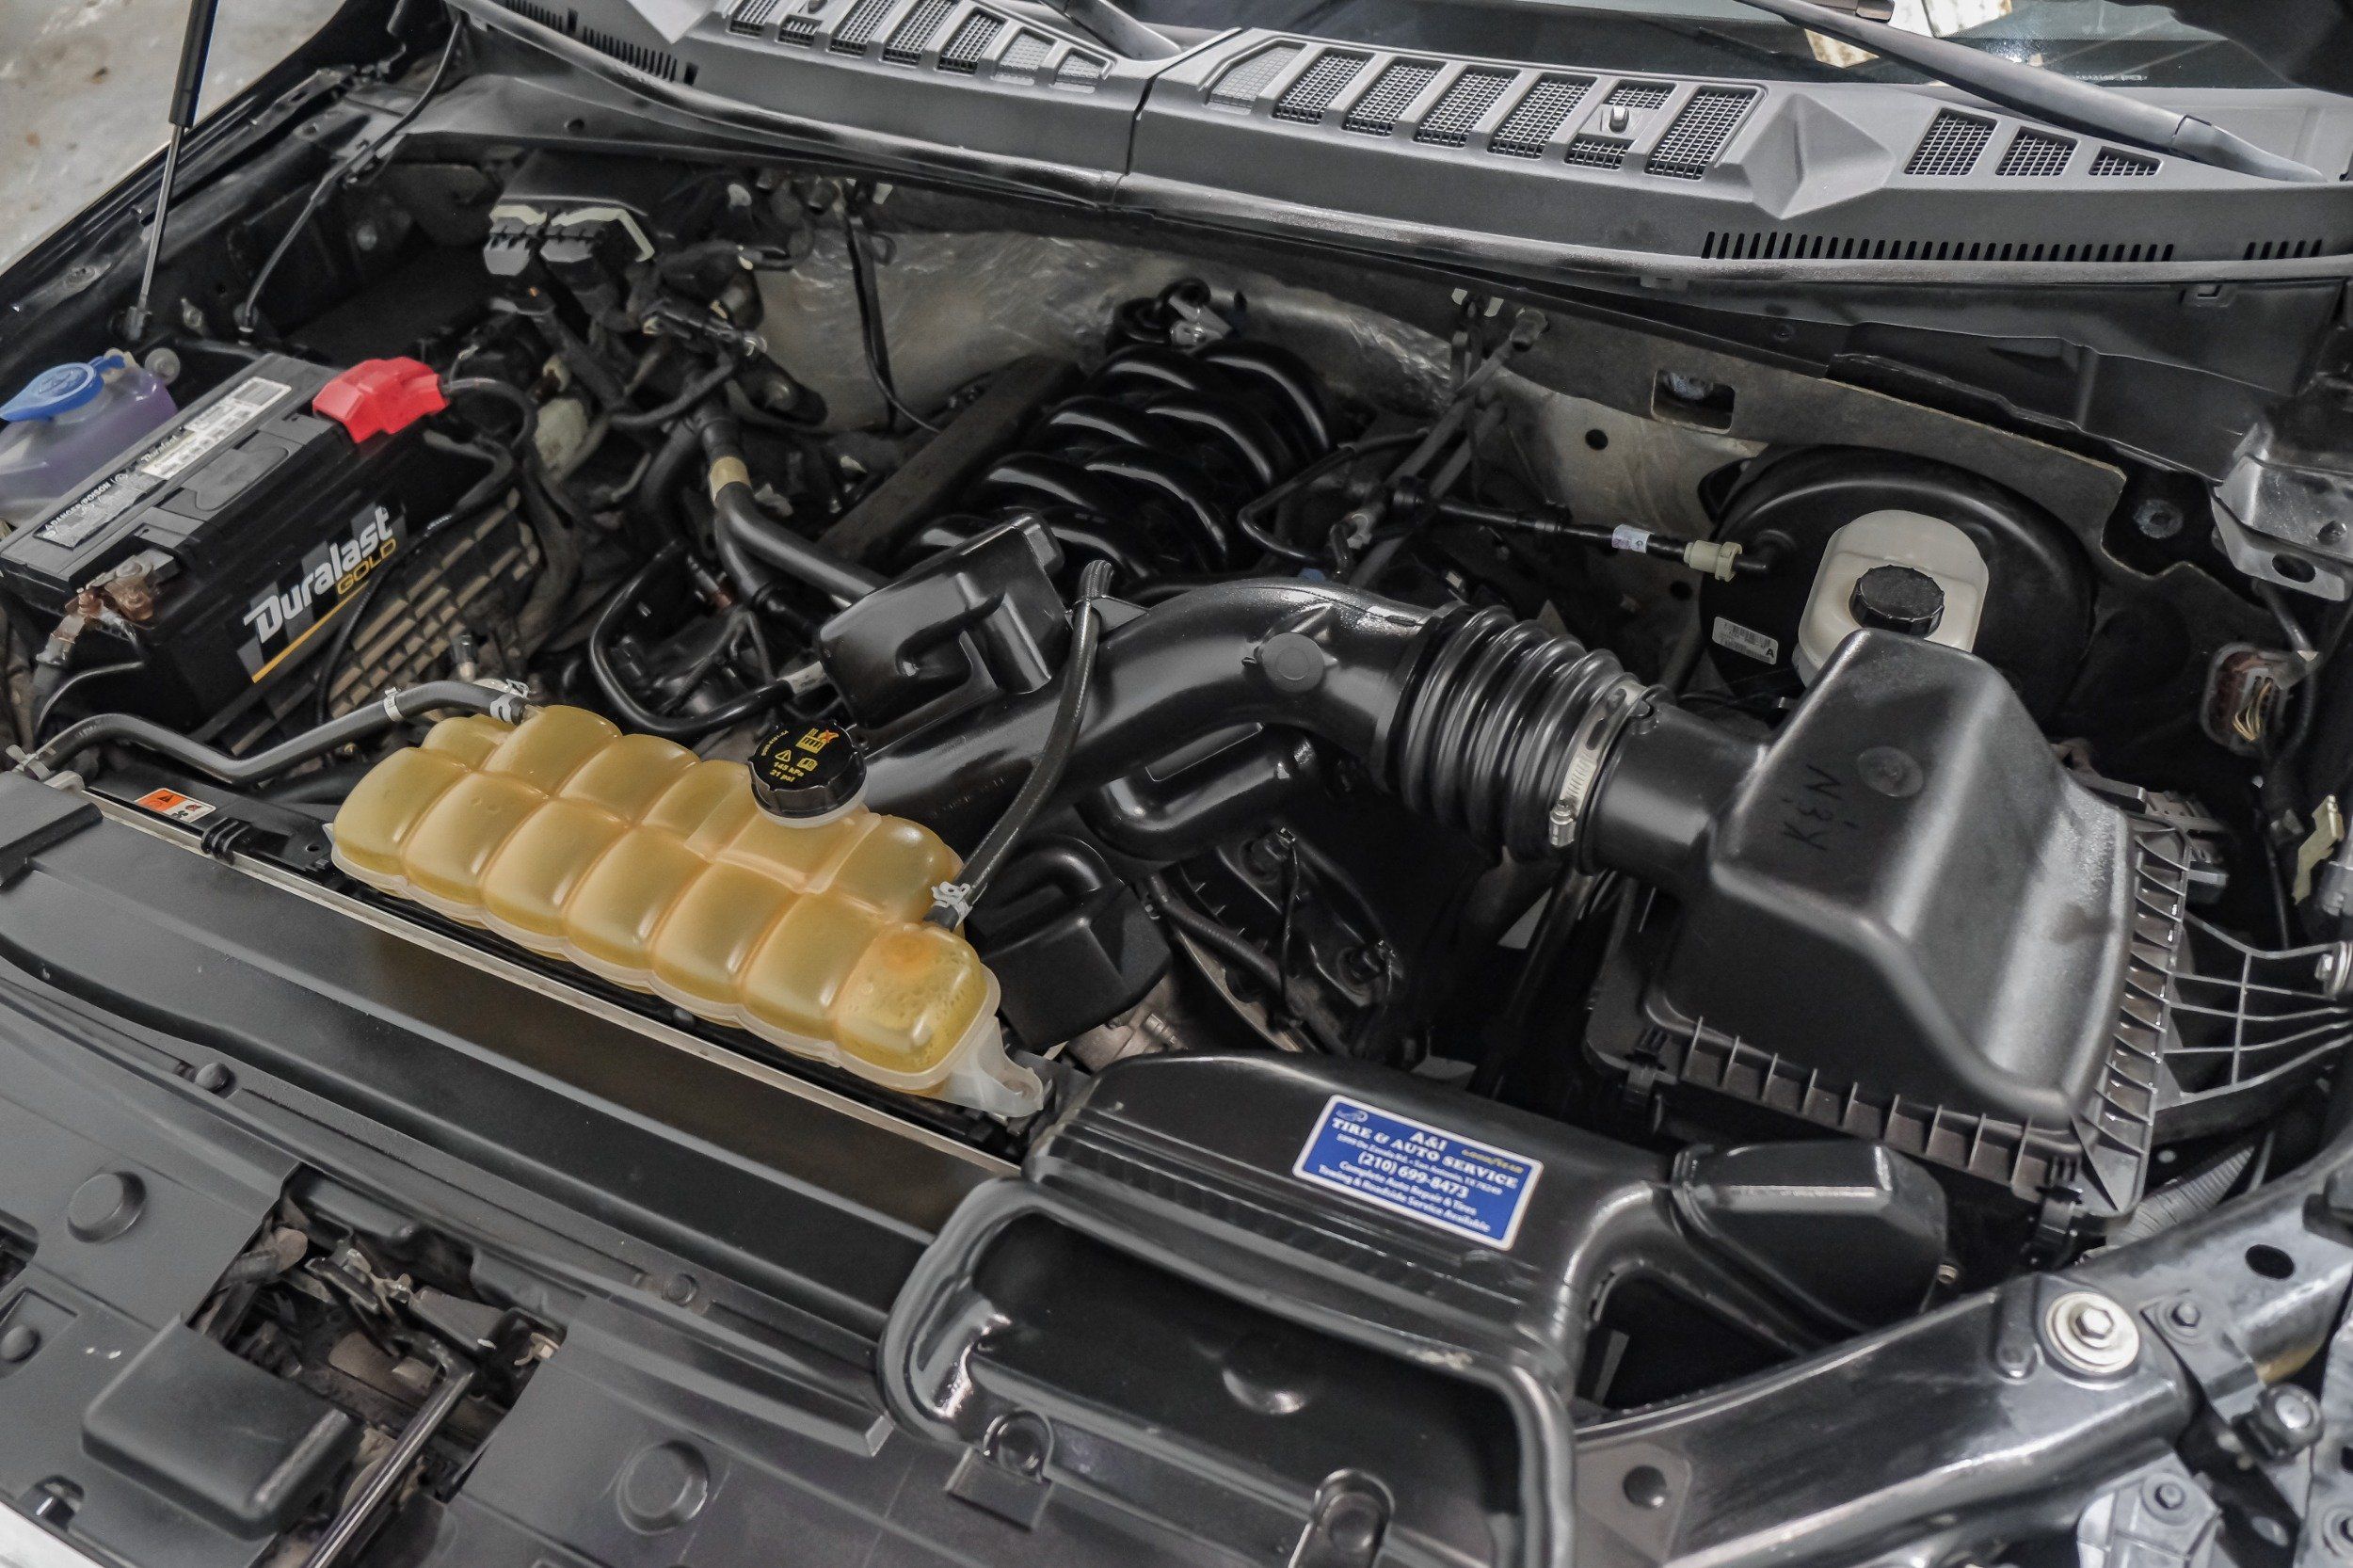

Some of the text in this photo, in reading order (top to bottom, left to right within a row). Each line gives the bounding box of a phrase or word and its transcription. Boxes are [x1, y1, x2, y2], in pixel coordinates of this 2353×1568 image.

[243, 505, 393, 644] Duralast
[336, 537, 396, 595] GOLD
[769, 769, 795, 783] 21 psi
[774, 761, 805, 777] 145 kPa
[1332, 1118, 1518, 1189] TIRE & AUTO SERVICE
[1410, 1132, 1447, 1151] A&I
[1319, 1164, 1490, 1232] Towing & Roadside Service Available
[1339, 1161, 1477, 1215] Complete Auto Repair & Tires
[1358, 1151, 1469, 1198] (210) 699-8473
